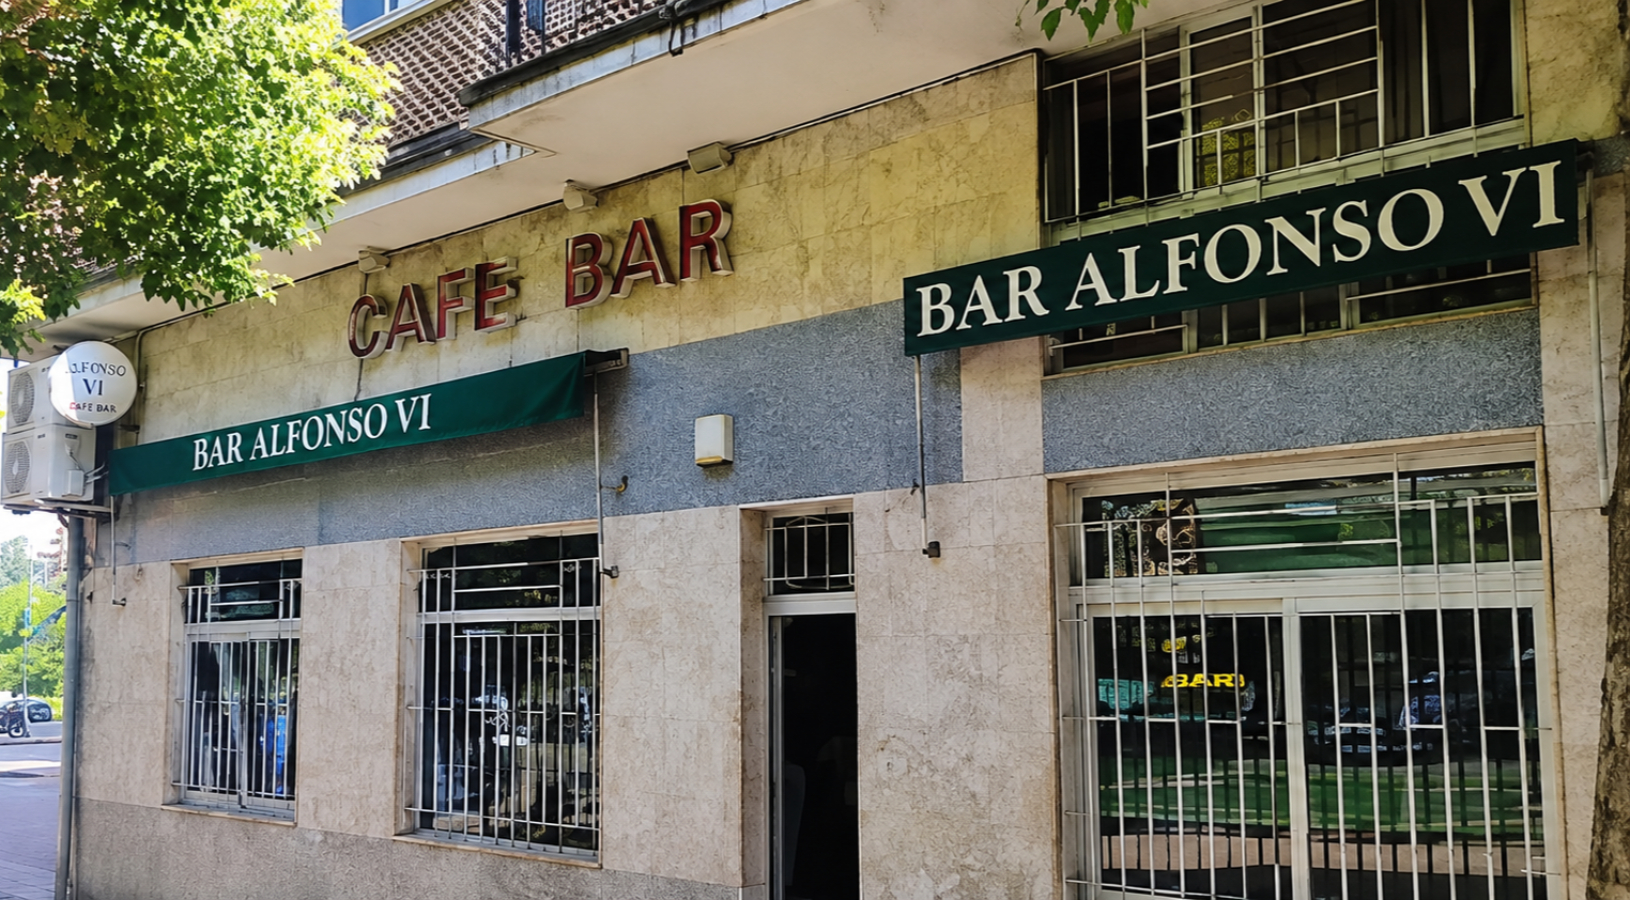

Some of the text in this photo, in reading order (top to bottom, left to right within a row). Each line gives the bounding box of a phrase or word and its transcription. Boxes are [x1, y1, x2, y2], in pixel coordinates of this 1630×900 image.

[348, 199, 733, 358] CAFE BAR
[916, 160, 1565, 338] BAR ALFONSO VI
[82, 378, 103, 396] VI
[96, 403, 117, 413] BAR
[193, 393, 432, 470] BAR ALFONSO VI
